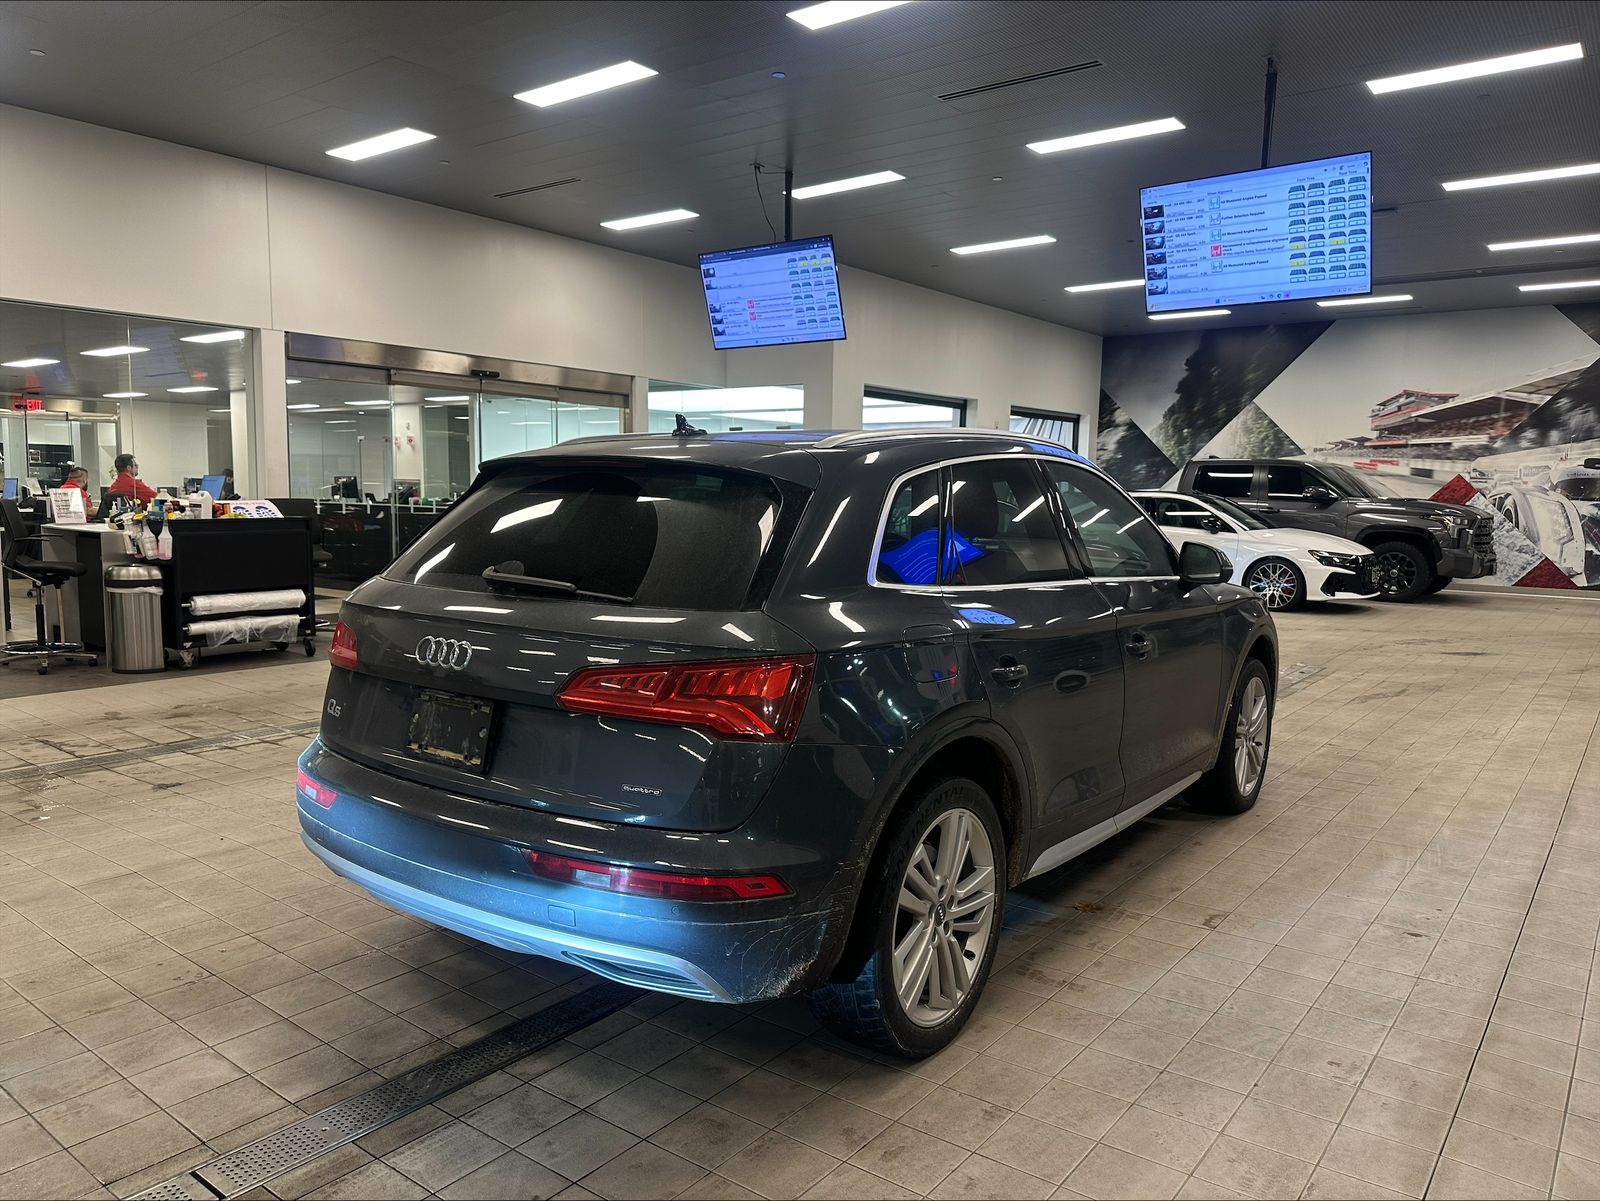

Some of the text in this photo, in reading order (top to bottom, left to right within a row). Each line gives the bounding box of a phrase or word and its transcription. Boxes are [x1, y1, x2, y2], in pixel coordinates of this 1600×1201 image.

[27, 400, 42, 410] EXIT
[328, 698, 341, 717] Q5
[623, 786, 660, 794] quattro
